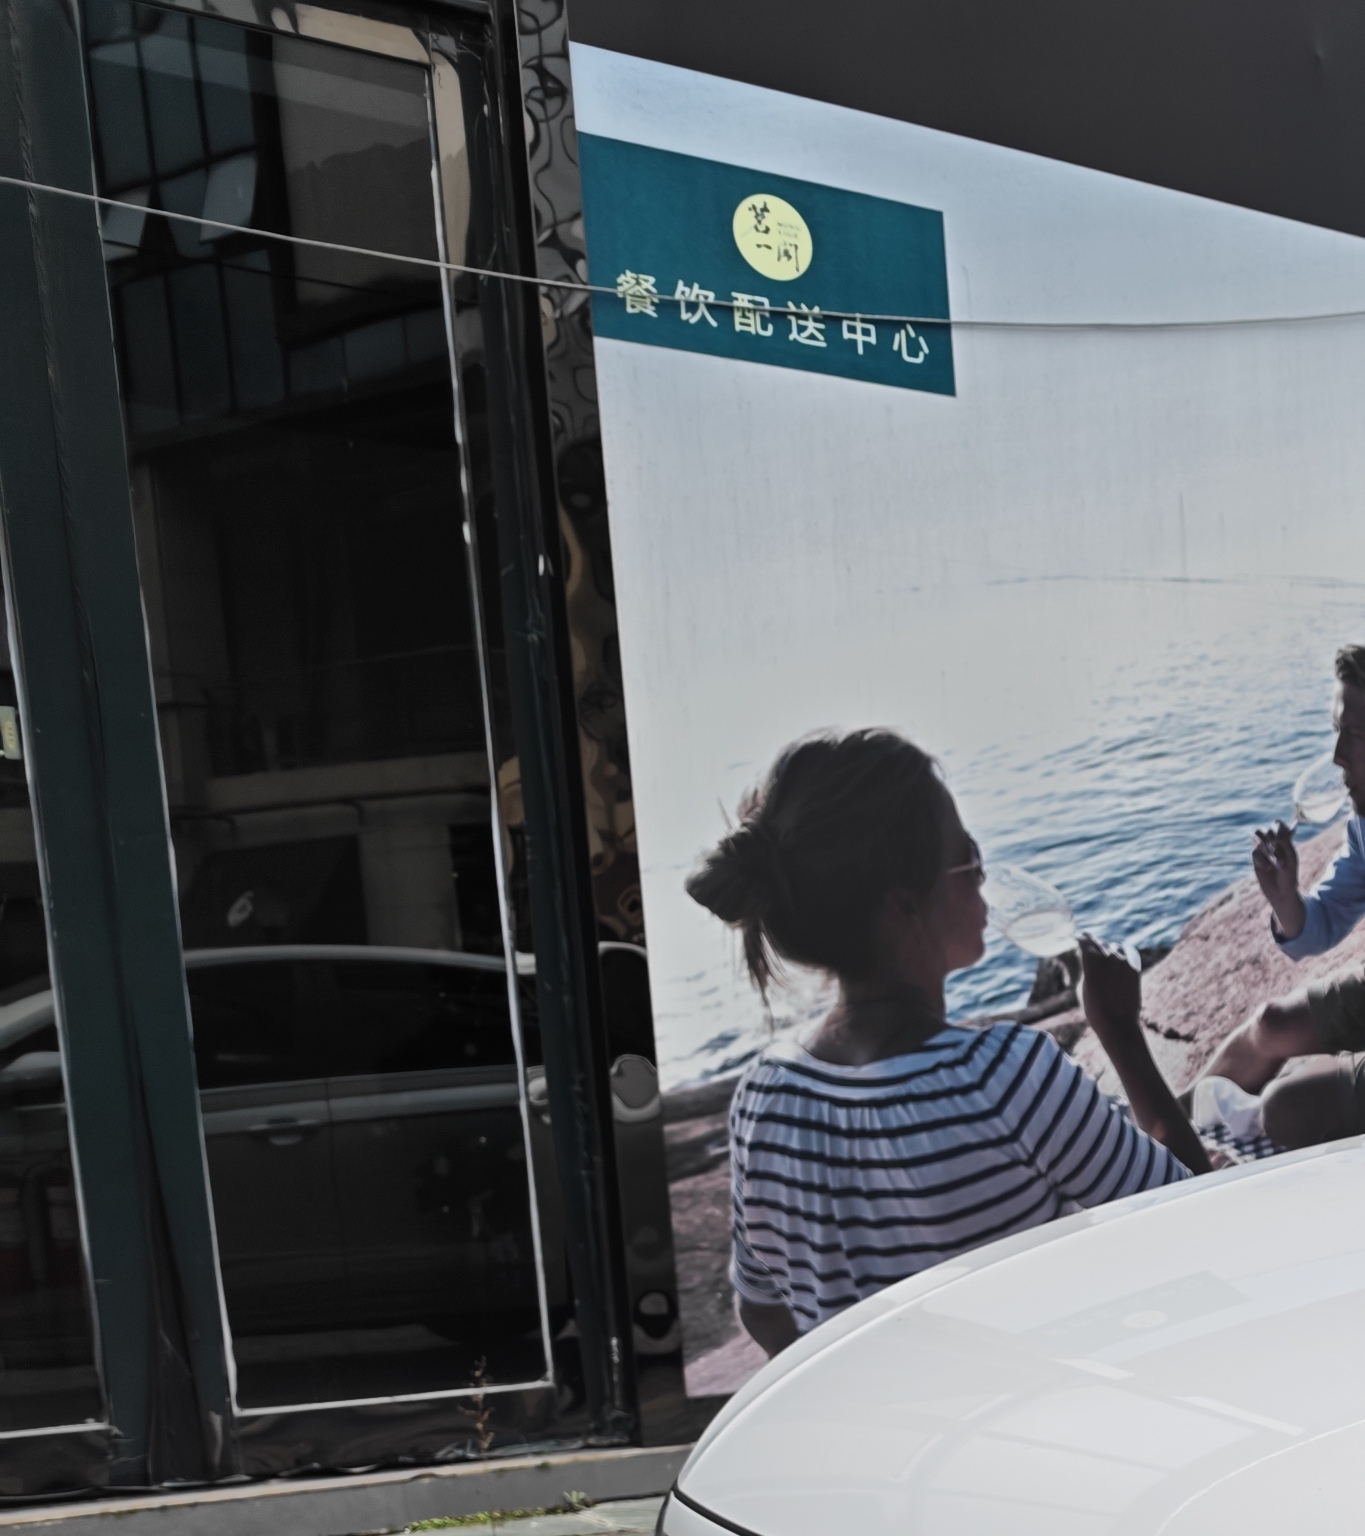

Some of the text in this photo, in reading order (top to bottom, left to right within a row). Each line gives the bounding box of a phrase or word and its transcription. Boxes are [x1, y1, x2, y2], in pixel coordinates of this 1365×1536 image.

[615, 268, 931, 365] 餐饮配送中心
